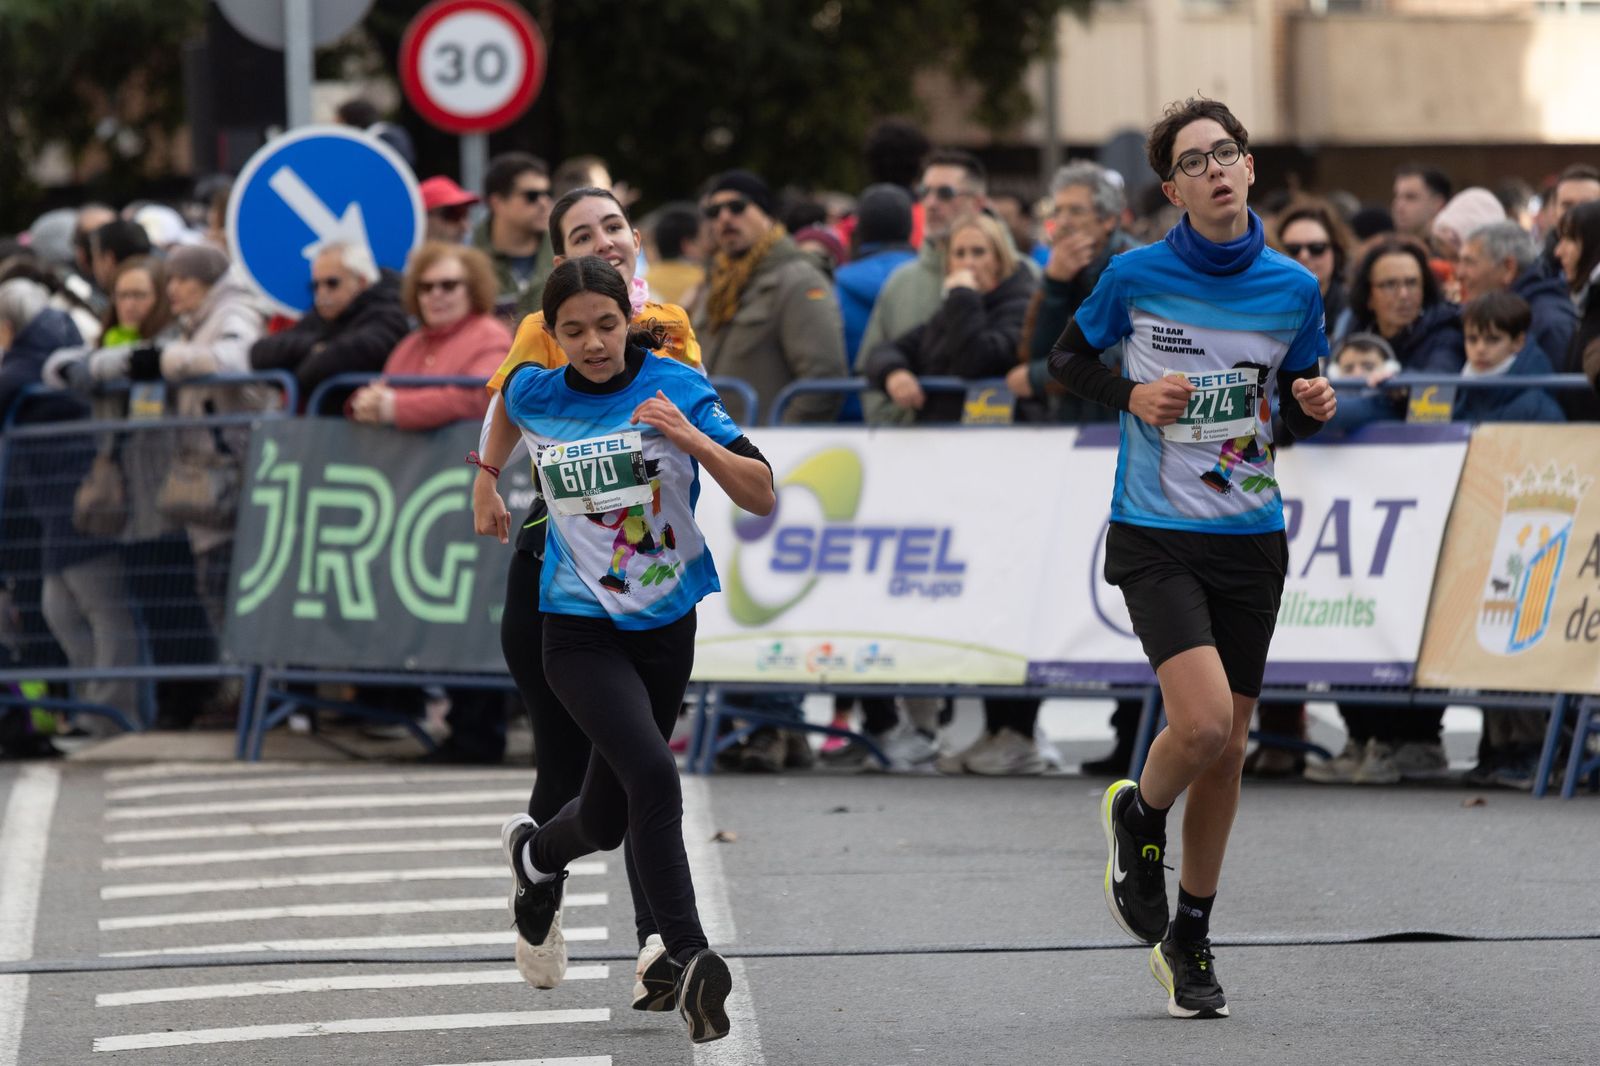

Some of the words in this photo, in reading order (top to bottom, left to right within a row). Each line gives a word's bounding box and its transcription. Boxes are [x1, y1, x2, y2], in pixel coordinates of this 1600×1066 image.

[434, 43, 508, 87] 30
[1152, 325, 1164, 334] XLI
[1166, 327, 1184, 336] SAN
[1151, 334, 1193, 346] SILVESTRE
[1151, 343, 1206, 356] SALMANTINA
[1188, 372, 1248, 388] SETEL
[1194, 417, 1215, 425] DIEGO
[566, 438, 632, 459] SETEL
[559, 456, 619, 493] 6170
[582, 487, 603, 497] IRENE
[769, 526, 968, 574] SETEL
[888, 576, 964, 600] Grupo
[1279, 591, 1377, 627] ilizantes
